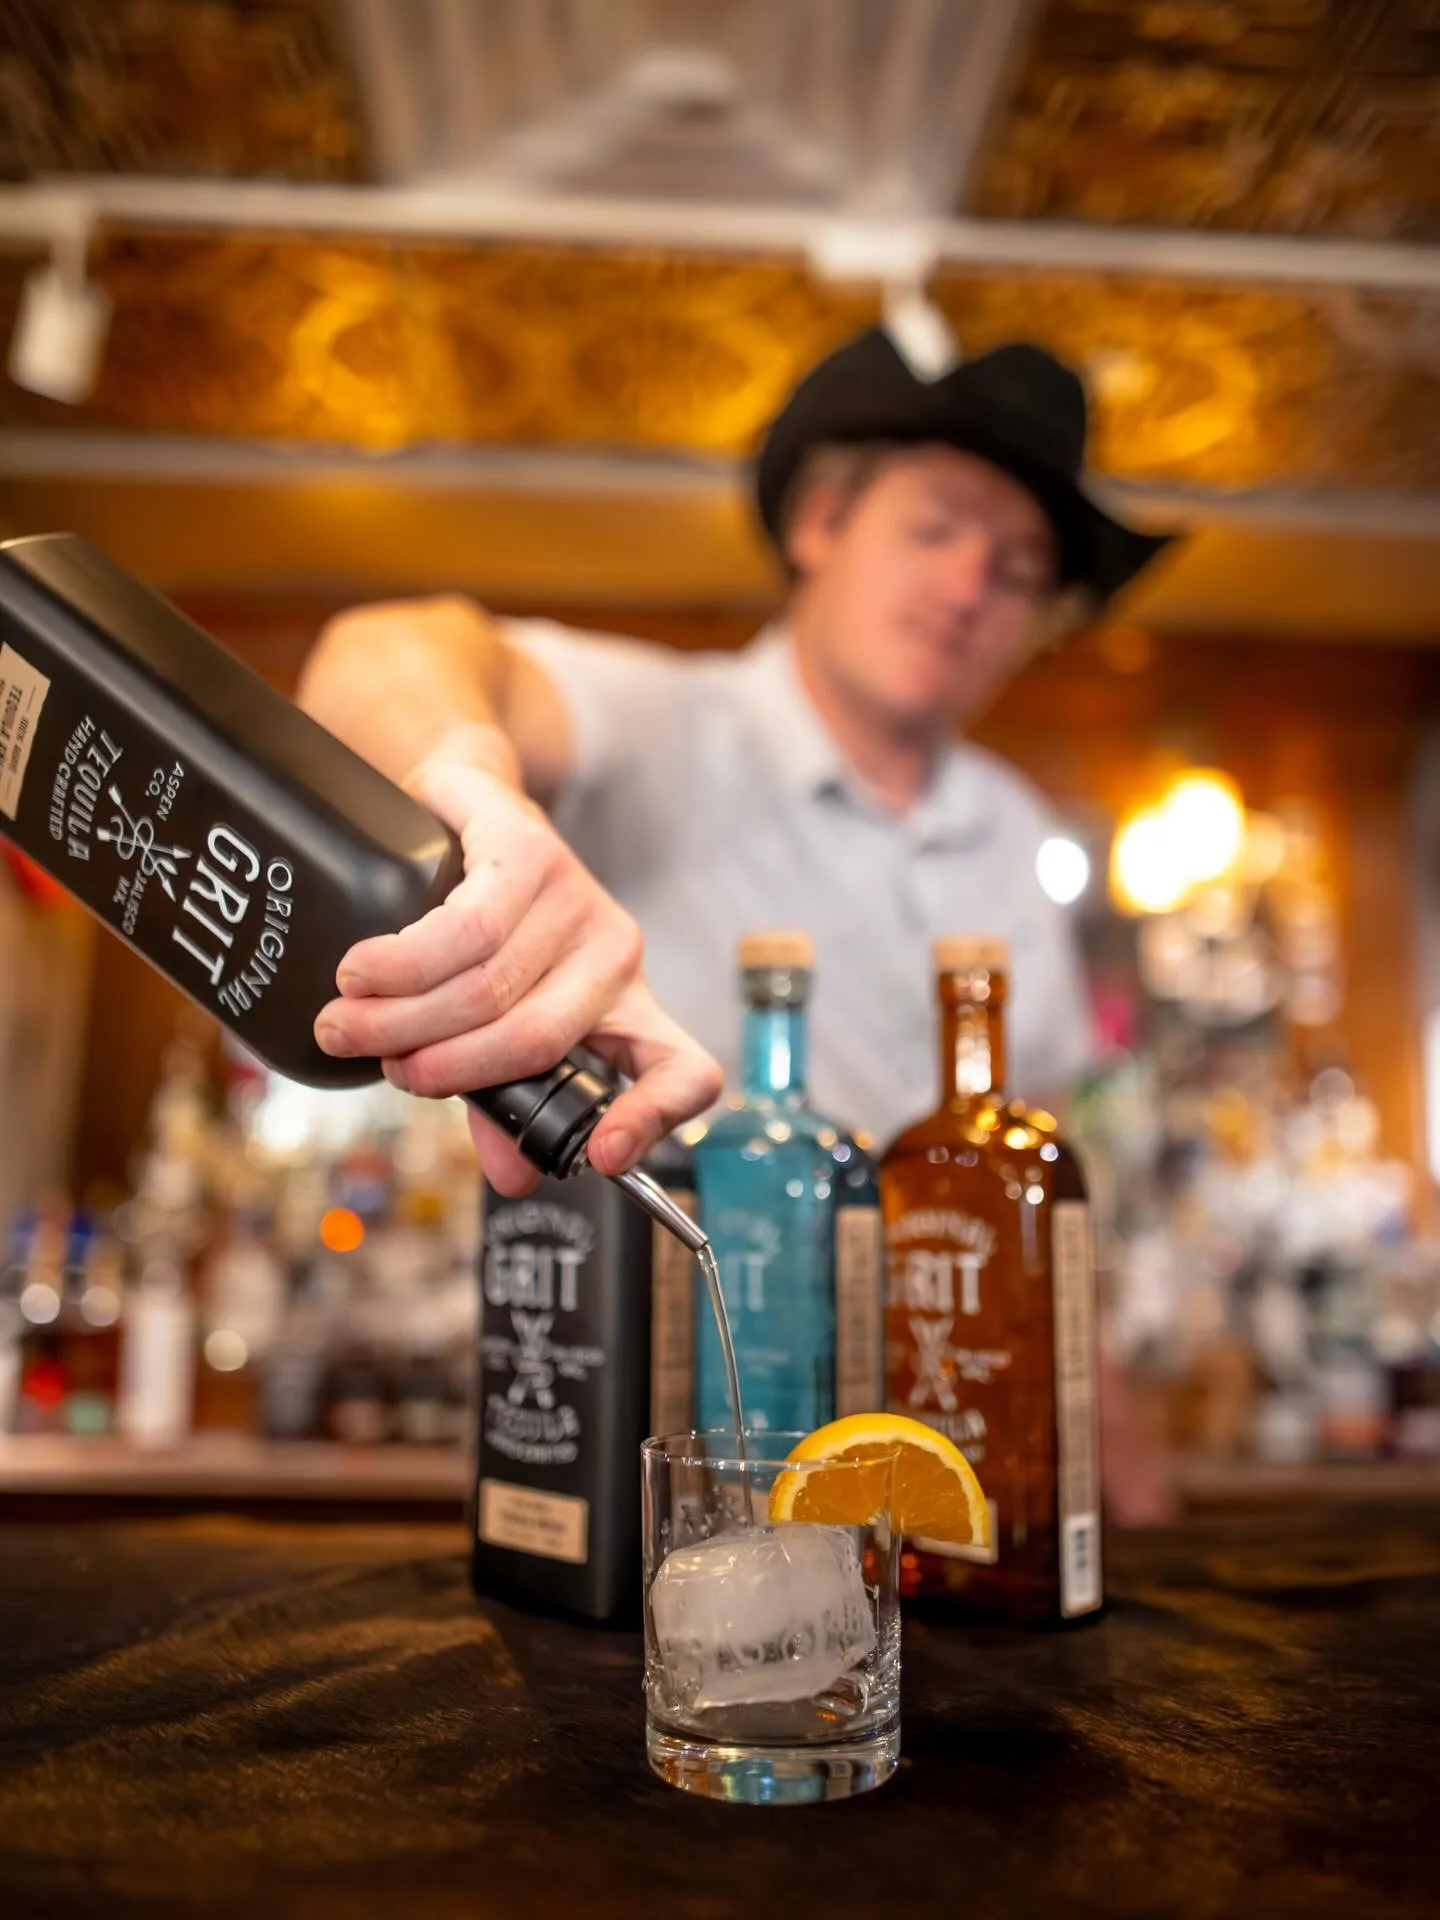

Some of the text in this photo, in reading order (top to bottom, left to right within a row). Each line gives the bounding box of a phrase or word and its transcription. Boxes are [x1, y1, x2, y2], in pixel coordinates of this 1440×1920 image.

[50, 715, 96, 841] HANDCRAFTED
[67, 729, 123, 861] TEQUILA
[156, 761, 184, 821] ASPEN
[123, 870, 148, 936] JALISCO
[172, 822, 261, 986] GRIT
[218, 856, 294, 1017] ORIGINAL
